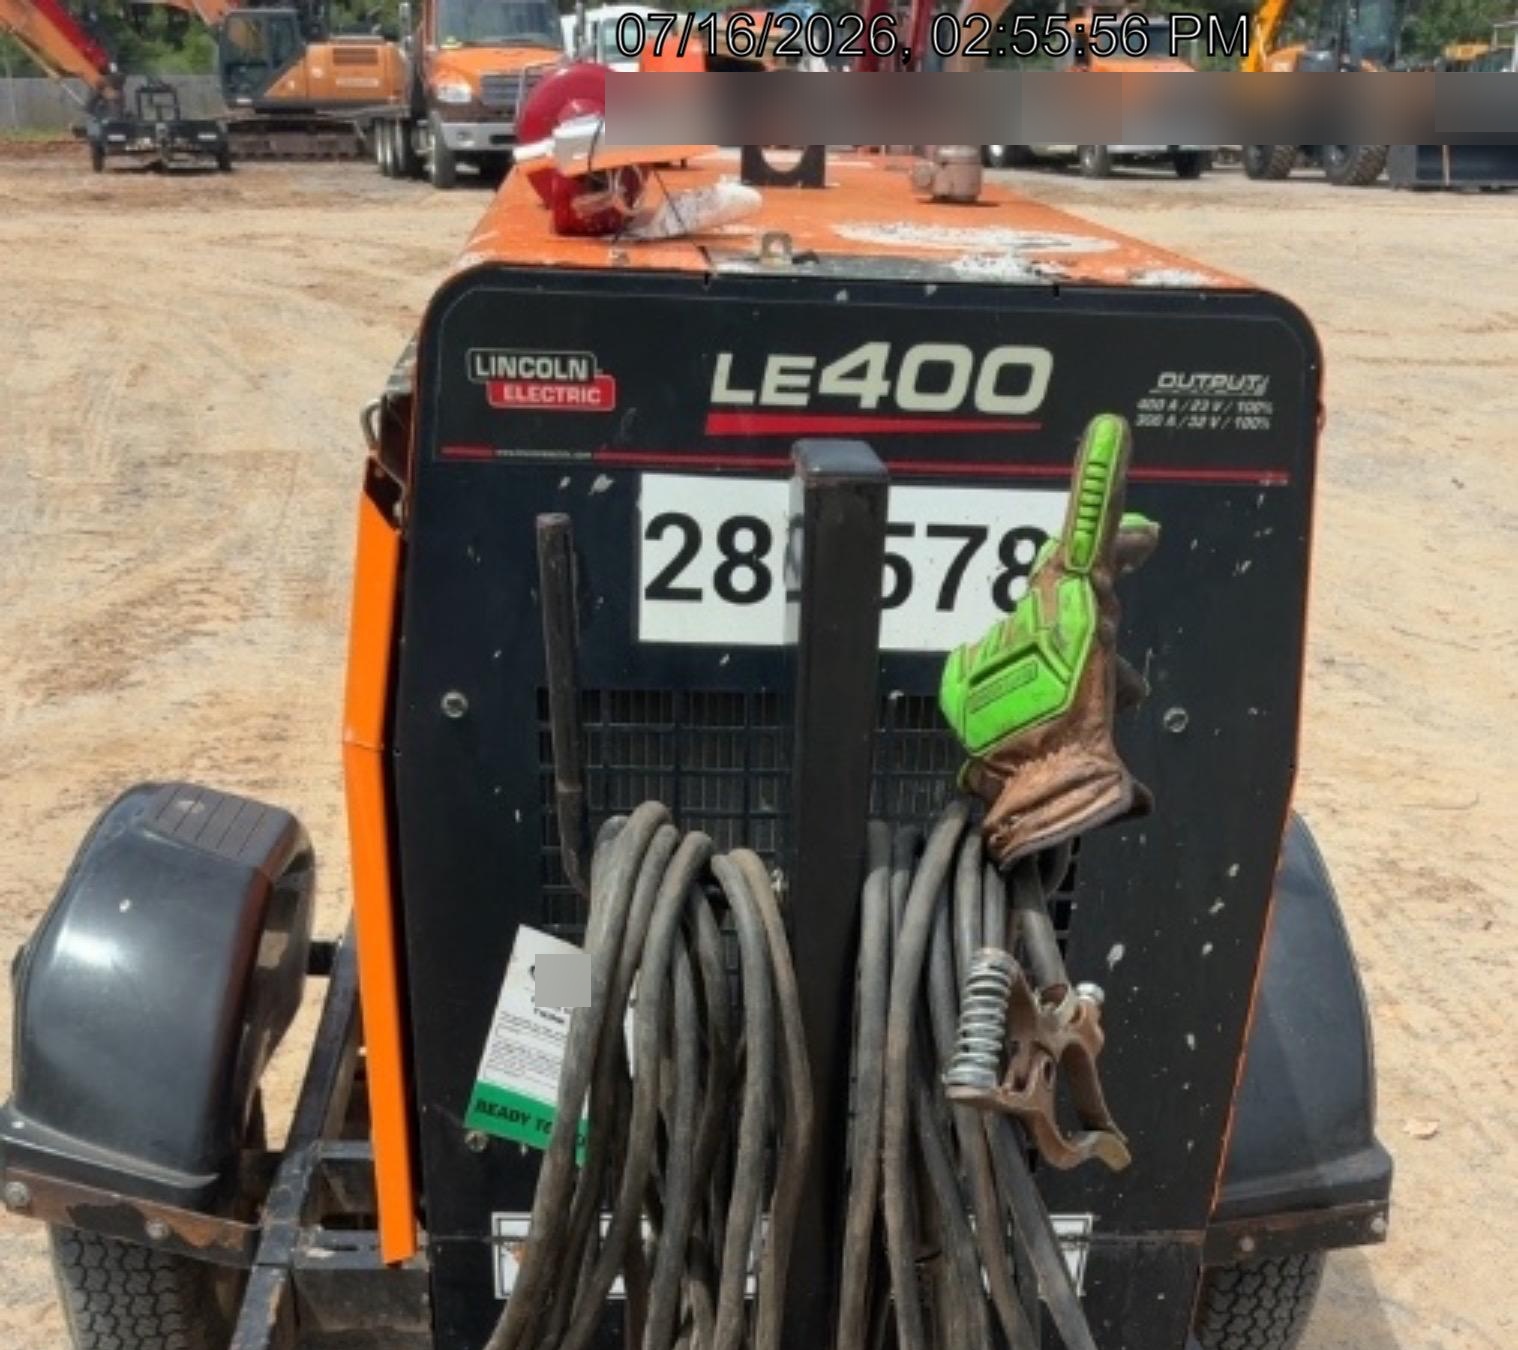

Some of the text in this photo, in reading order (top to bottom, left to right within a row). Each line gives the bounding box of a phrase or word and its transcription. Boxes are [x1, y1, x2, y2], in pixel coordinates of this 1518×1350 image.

[476, 354, 589, 381] LINCOLN
[710, 341, 1054, 415] LE400
[1157, 371, 1264, 391] OUTPUT
[503, 384, 602, 404] ELECTRIC
[644, 512, 1051, 613] 28578
[475, 1098, 532, 1126] READY
